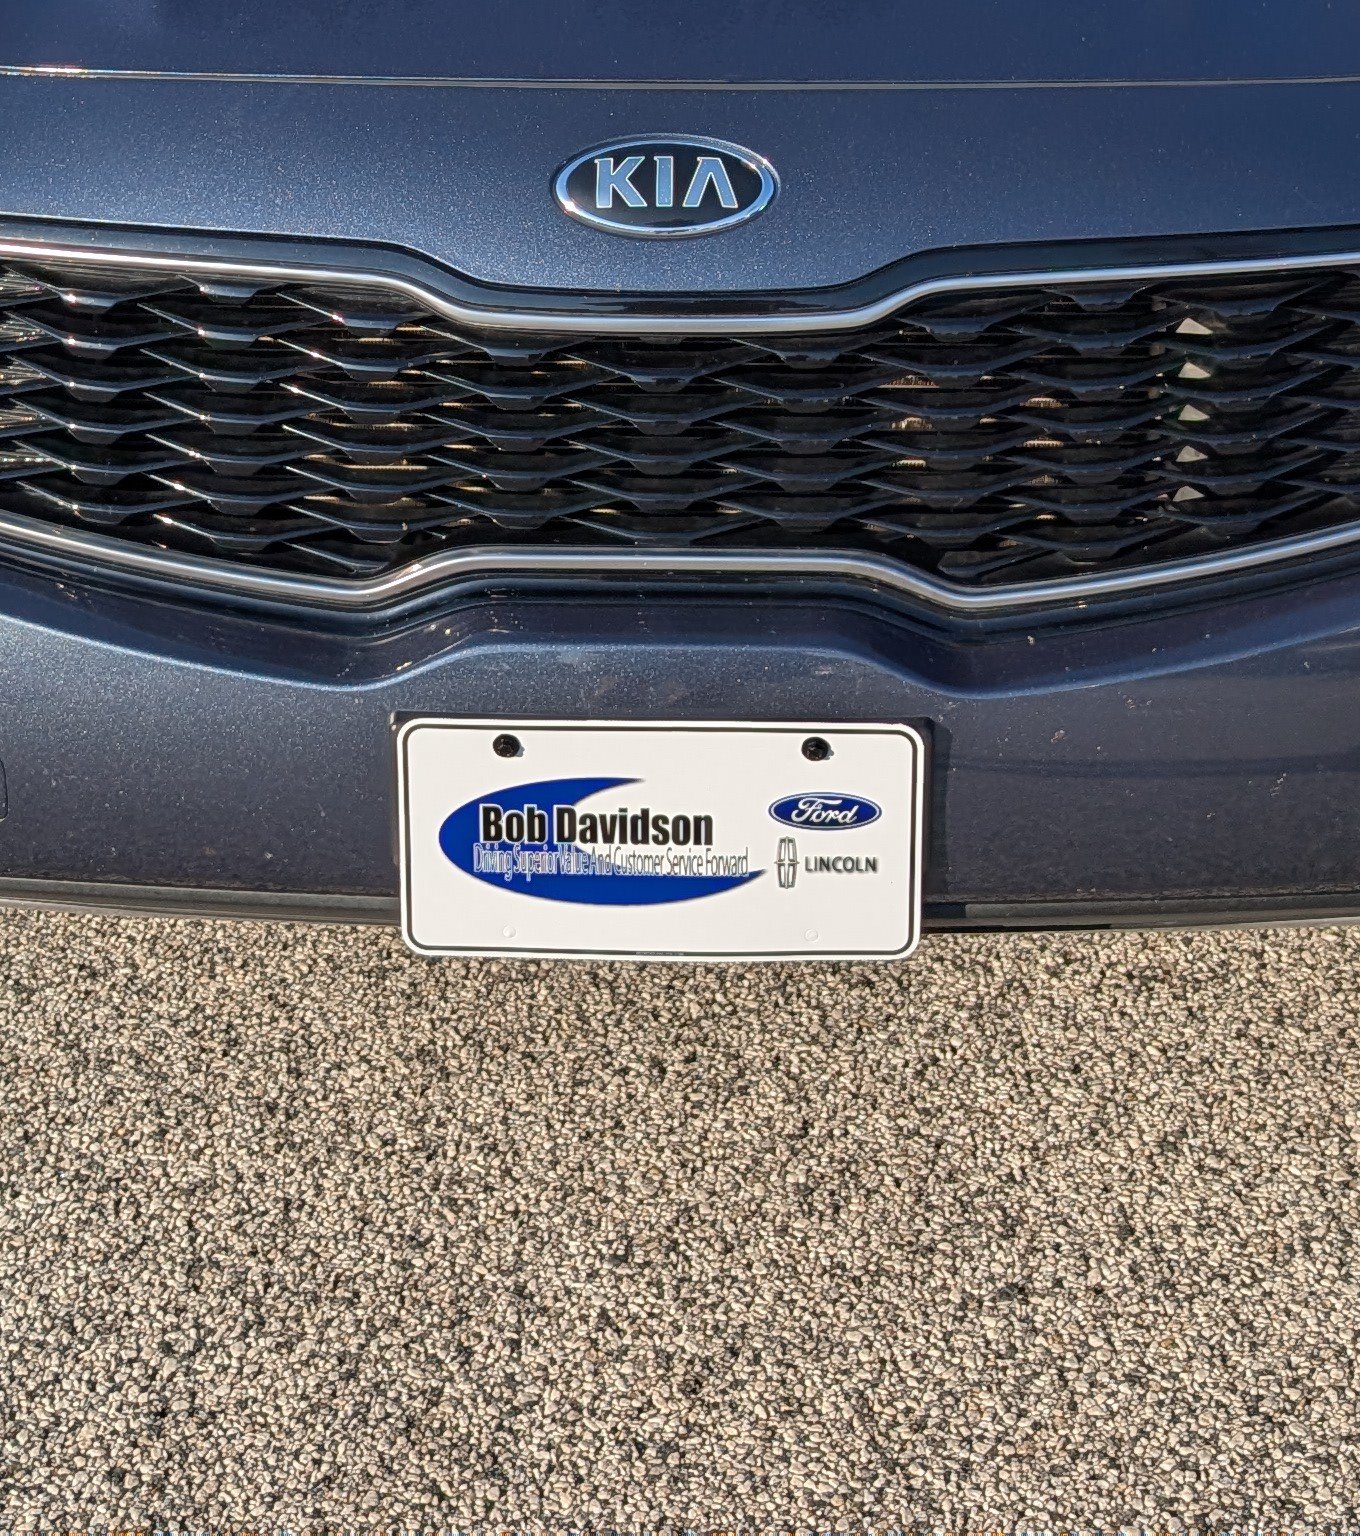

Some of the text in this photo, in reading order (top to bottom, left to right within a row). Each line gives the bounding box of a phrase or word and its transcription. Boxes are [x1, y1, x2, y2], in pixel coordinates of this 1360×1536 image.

[594, 155, 739, 208] KIA
[480, 804, 714, 846] Bob Davidson
[790, 797, 859, 823] Ford
[474, 843, 749, 881] Driving Superior Value And Customer Service Forward
[805, 855, 878, 874] LINCOLN
